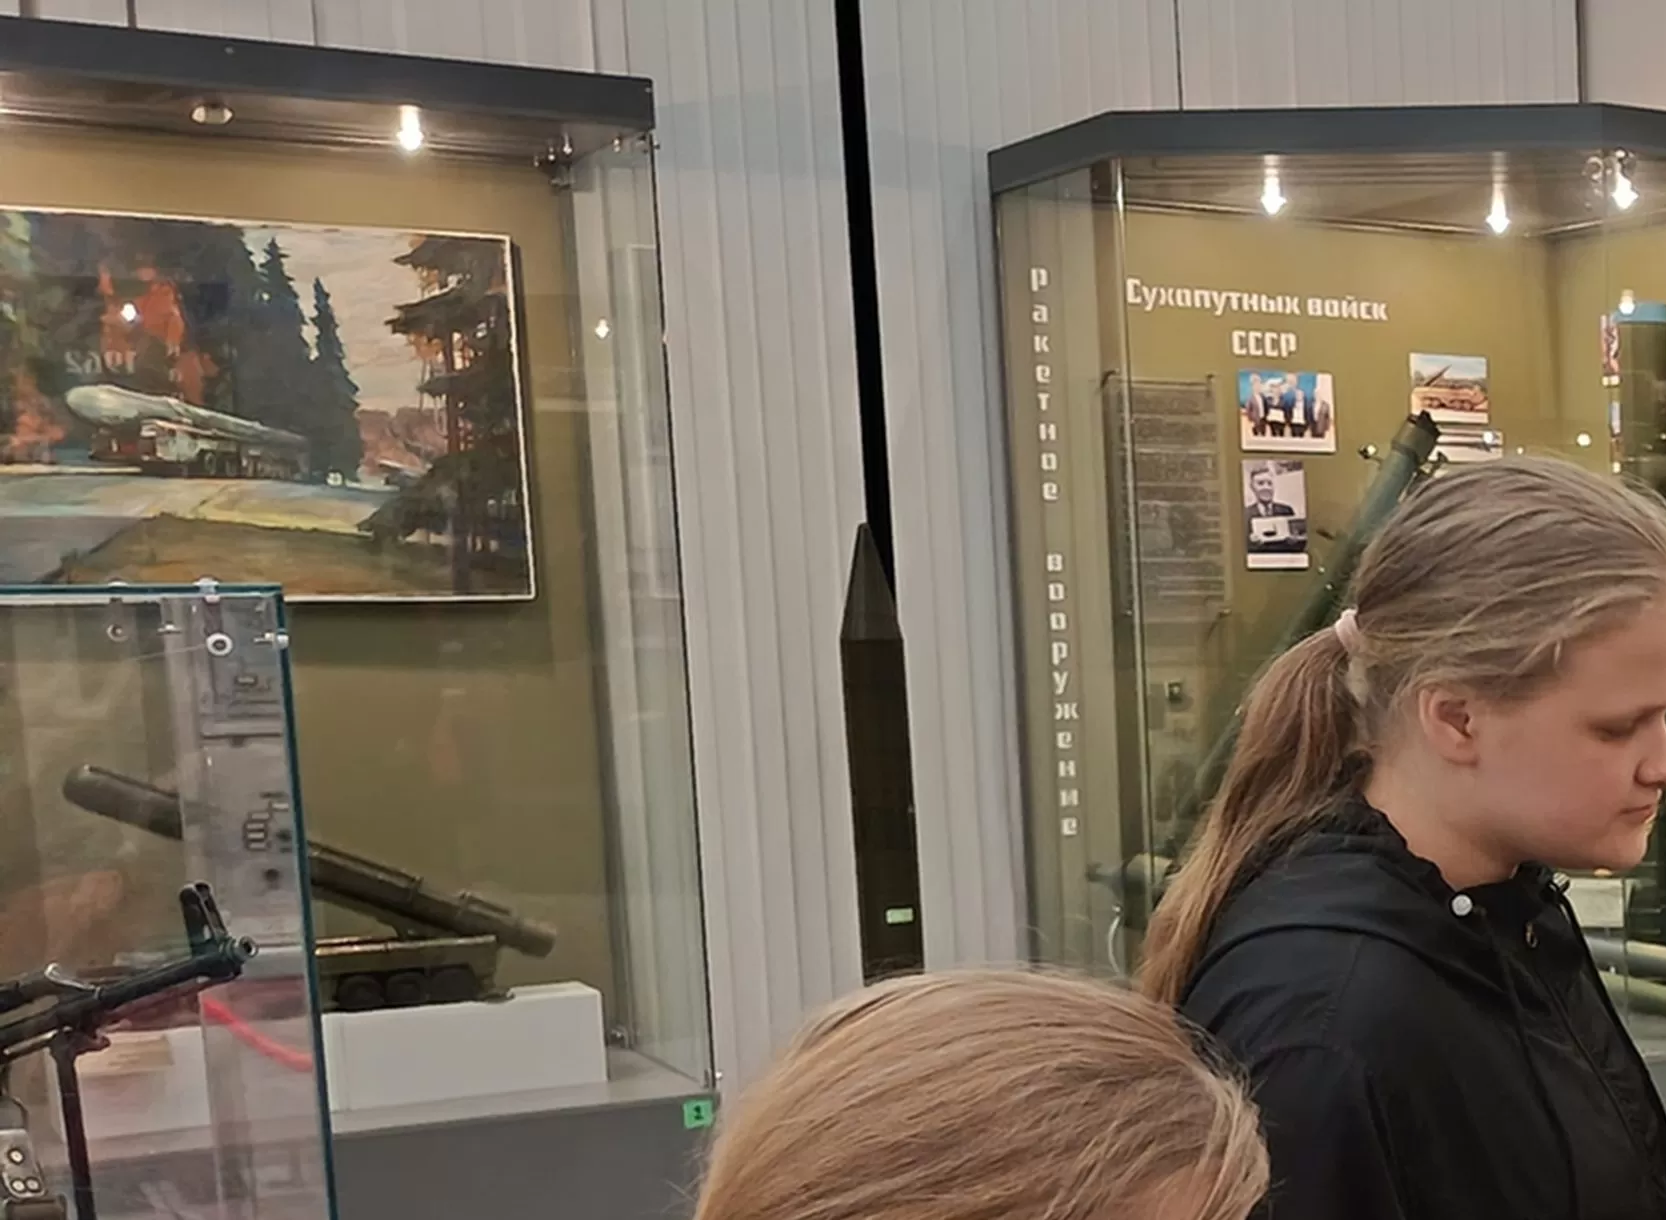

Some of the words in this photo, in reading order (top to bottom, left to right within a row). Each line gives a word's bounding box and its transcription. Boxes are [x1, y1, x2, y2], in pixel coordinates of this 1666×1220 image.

[1125, 277, 1302, 317] Сухопутных
[1306, 295, 1390, 321] войск
[1230, 329, 1298, 358] СССР
[1046, 553, 1080, 837] вооружение
